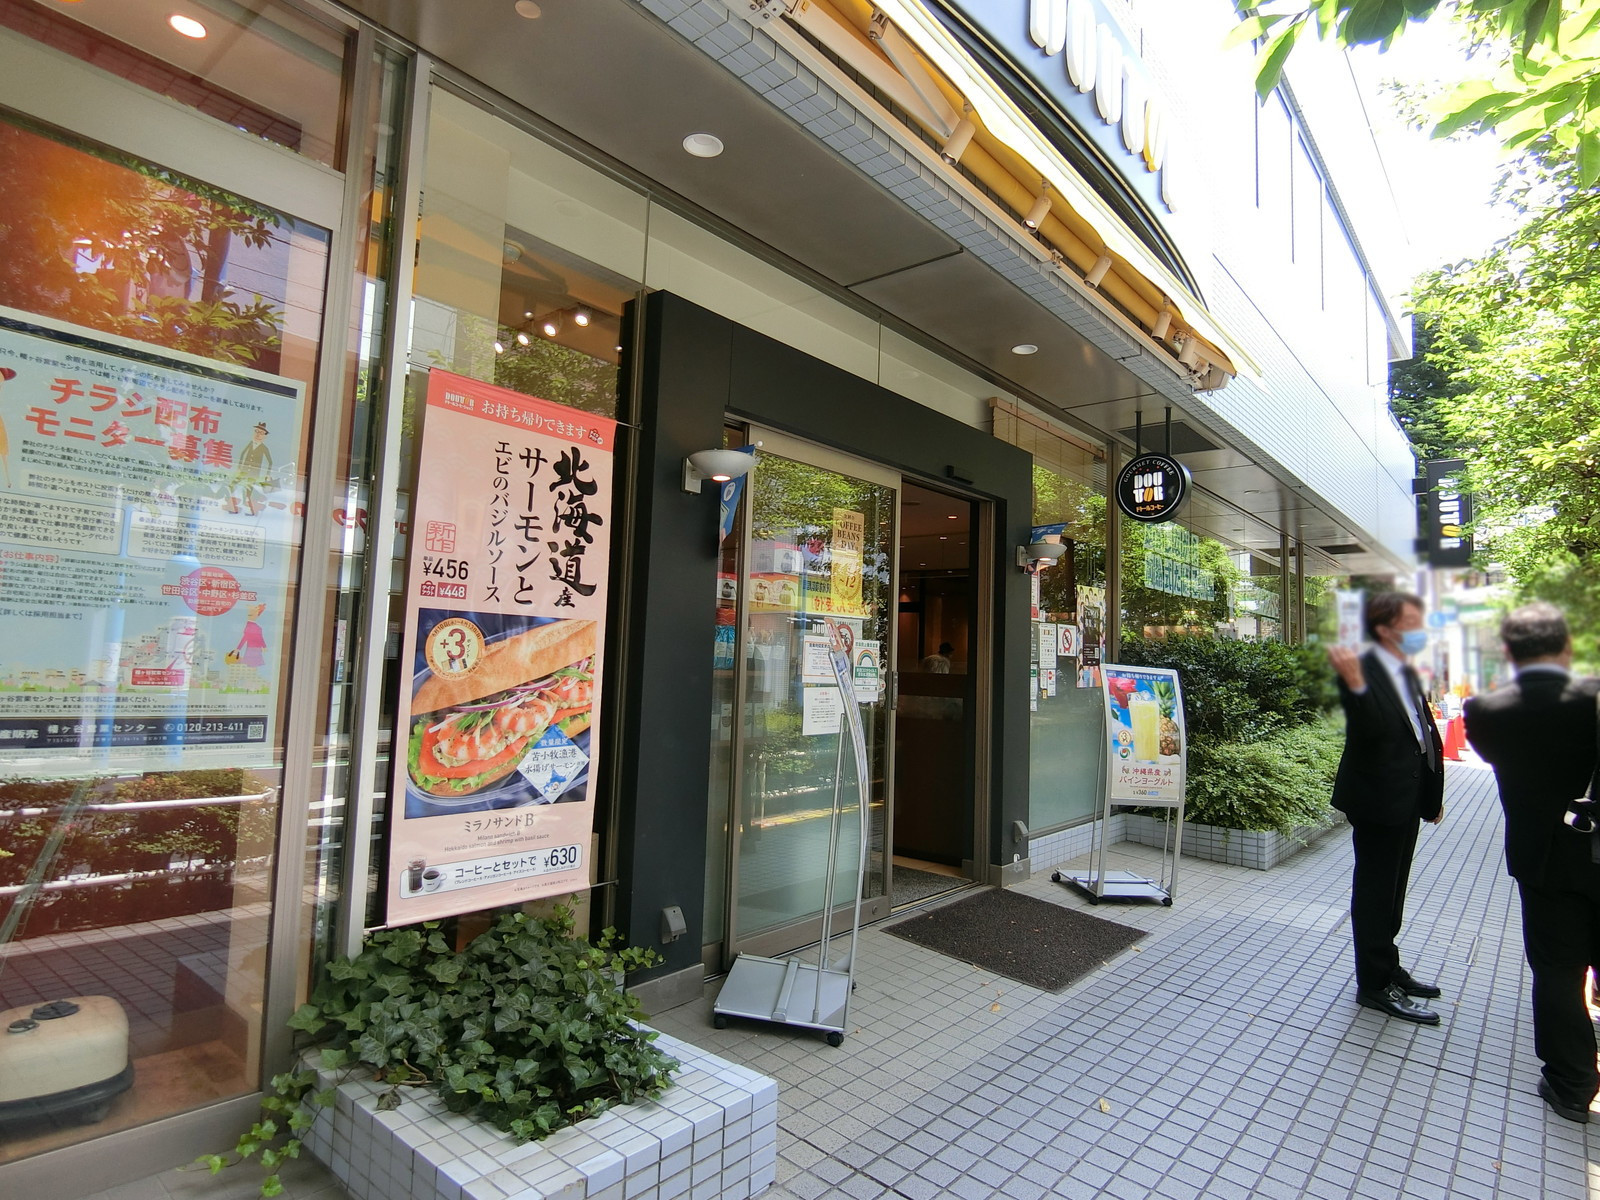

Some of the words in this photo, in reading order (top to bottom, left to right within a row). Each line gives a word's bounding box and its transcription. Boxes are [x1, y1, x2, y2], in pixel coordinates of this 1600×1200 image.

[50, 378, 222, 434] チラシ配布
[481, 400, 587, 440] お持ち帰りできます
[25, 407, 234, 469] モニター募集
[1123, 459, 1151, 483] GOURMET
[1152, 459, 1175, 476] COFFEE
[483, 440, 513, 603] エビのバジルソース
[514, 447, 548, 605] サーモンと
[837, 529, 860, 542] BEANS
[423, 557, 469, 580] ¥456
[162, 585, 257, 600] 世田谷区・中野区・杉並区
[440, 585, 465, 597] ¥448
[176, 722, 243, 733] 0120-213-411
[1119, 776, 1174, 787] パインヨーグルト
[455, 855, 537, 878] コーヒーとセットで
[543, 846, 577, 868] ¥630
